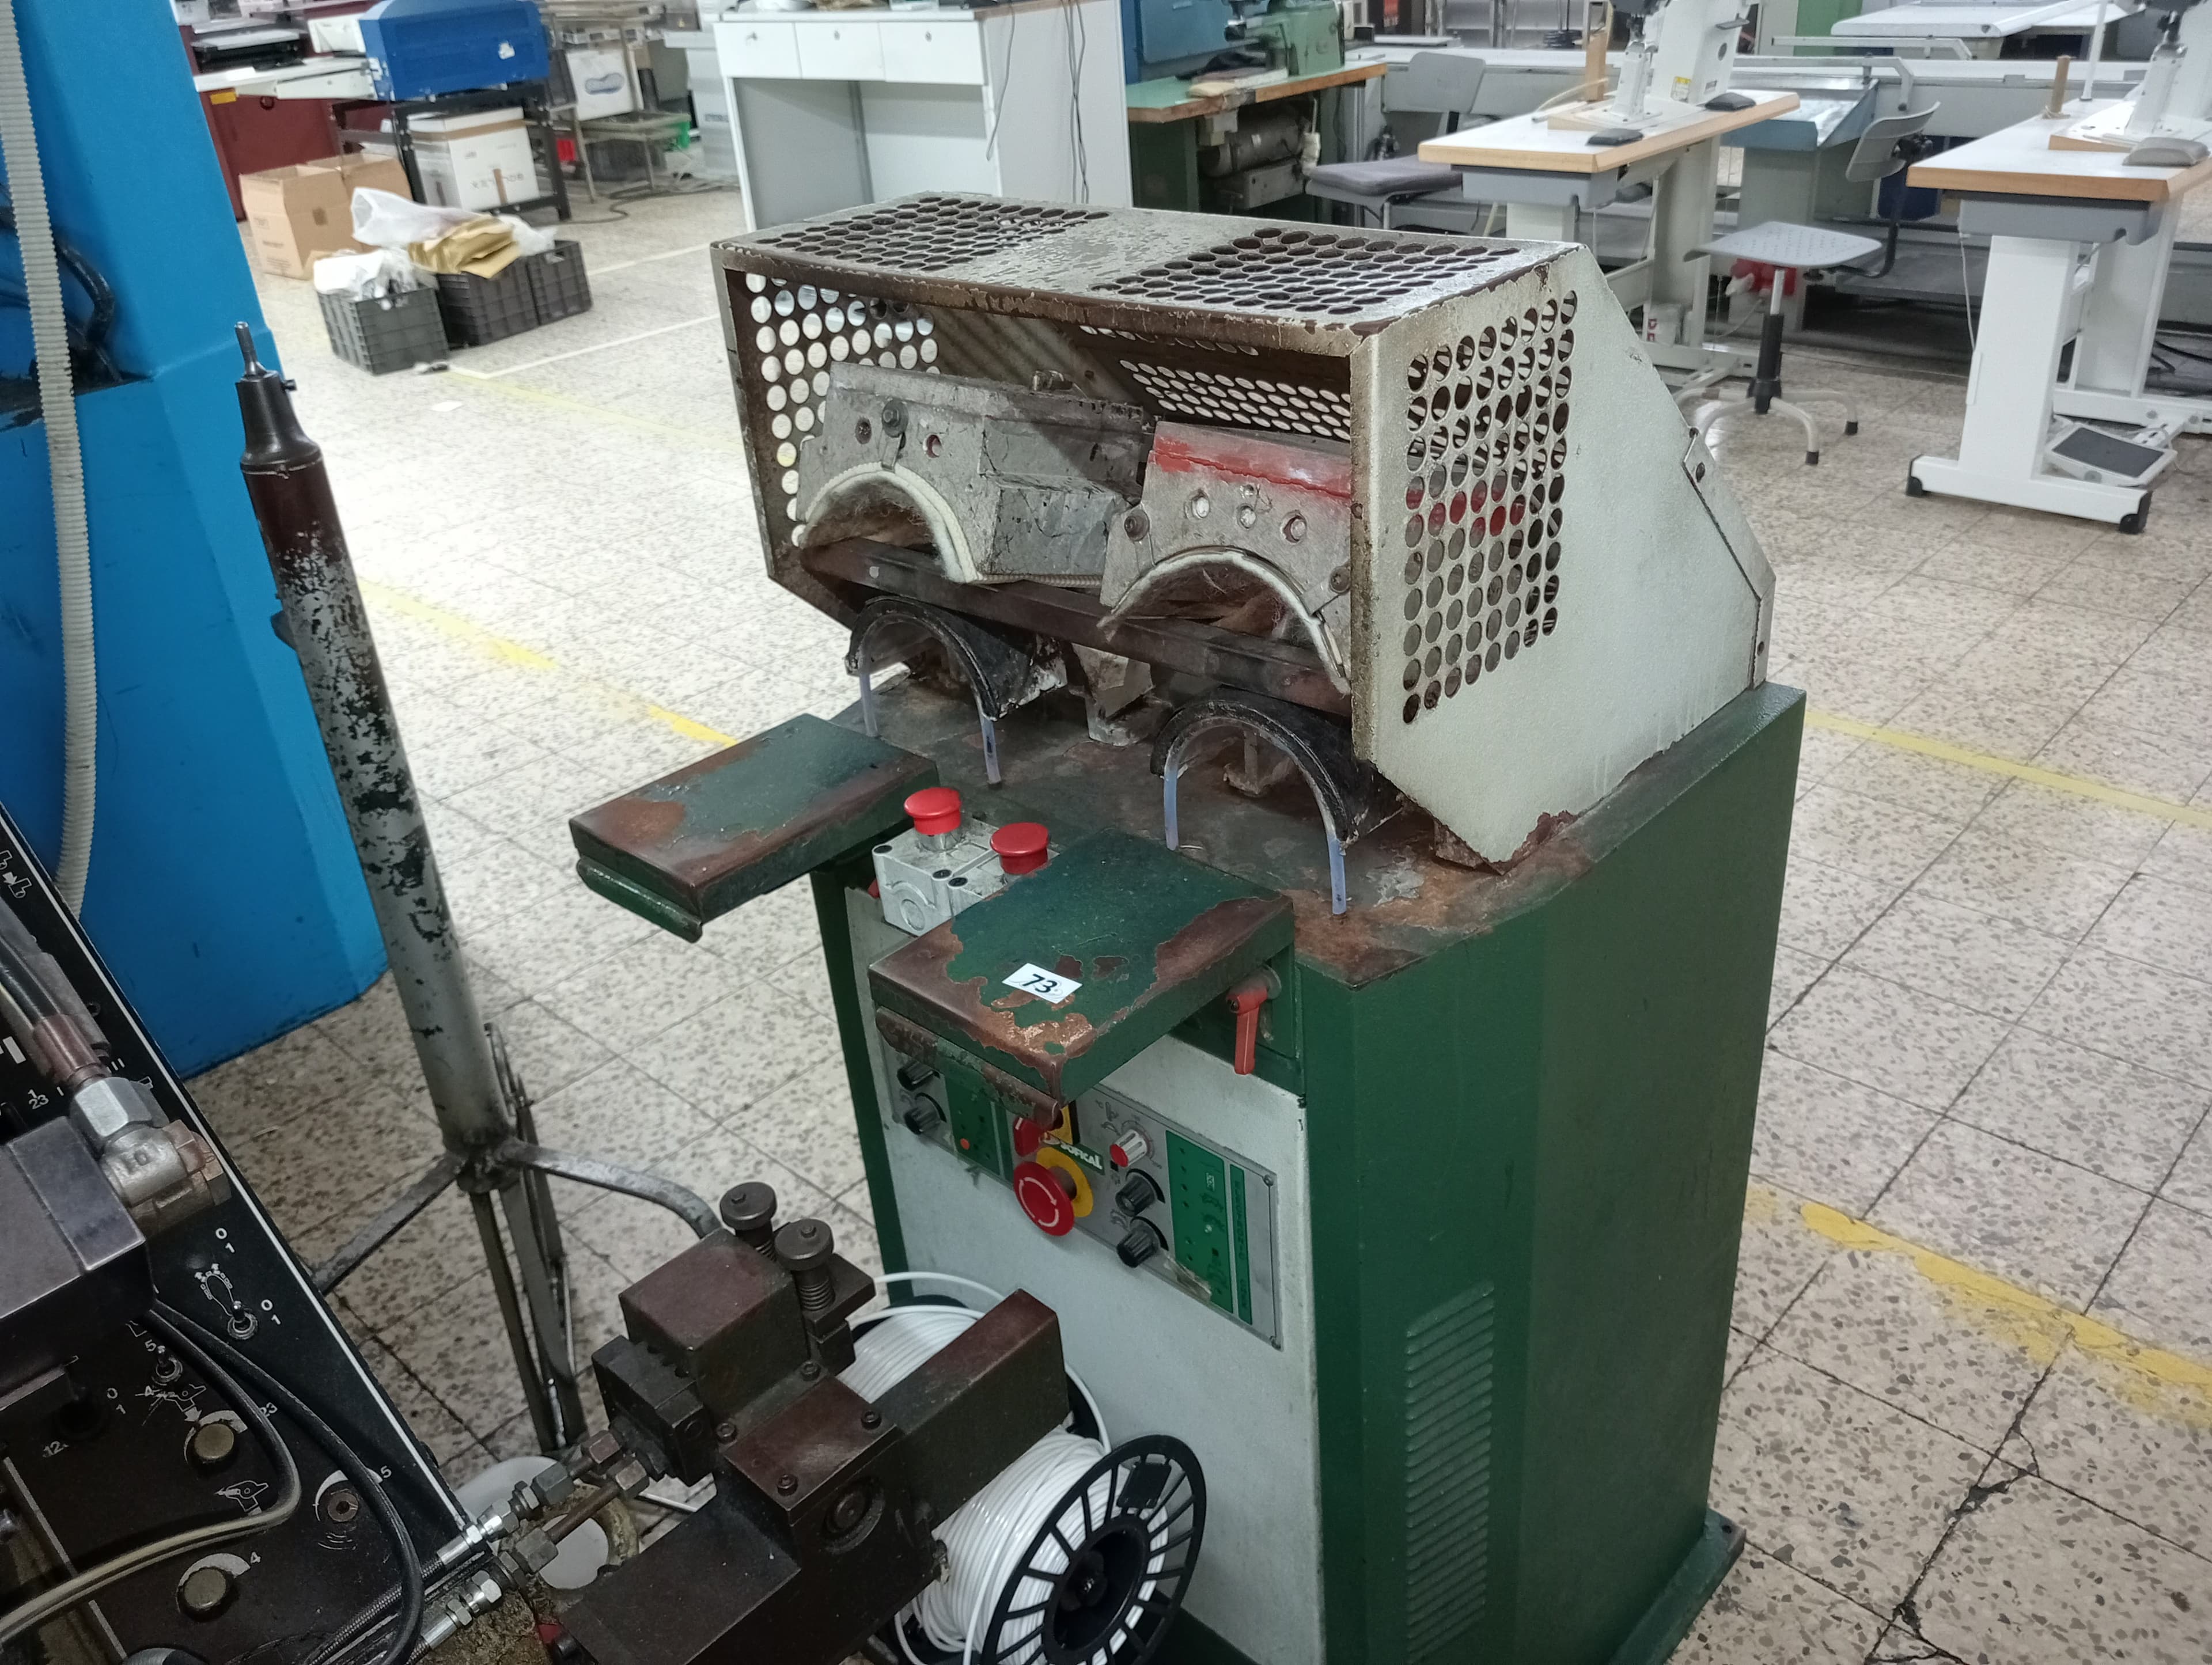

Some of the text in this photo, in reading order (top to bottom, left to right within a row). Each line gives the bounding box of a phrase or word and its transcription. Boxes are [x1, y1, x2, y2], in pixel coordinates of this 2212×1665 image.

[1022, 973, 1058, 993] 73
[28, 1094, 50, 1110] 23
[225, 1242, 235, 1253] 1
[271, 1314, 281, 1325] 1
[116, 1404, 126, 1414] 1
[380, 1466, 392, 1478] 5
[250, 1552, 261, 1564] 4
